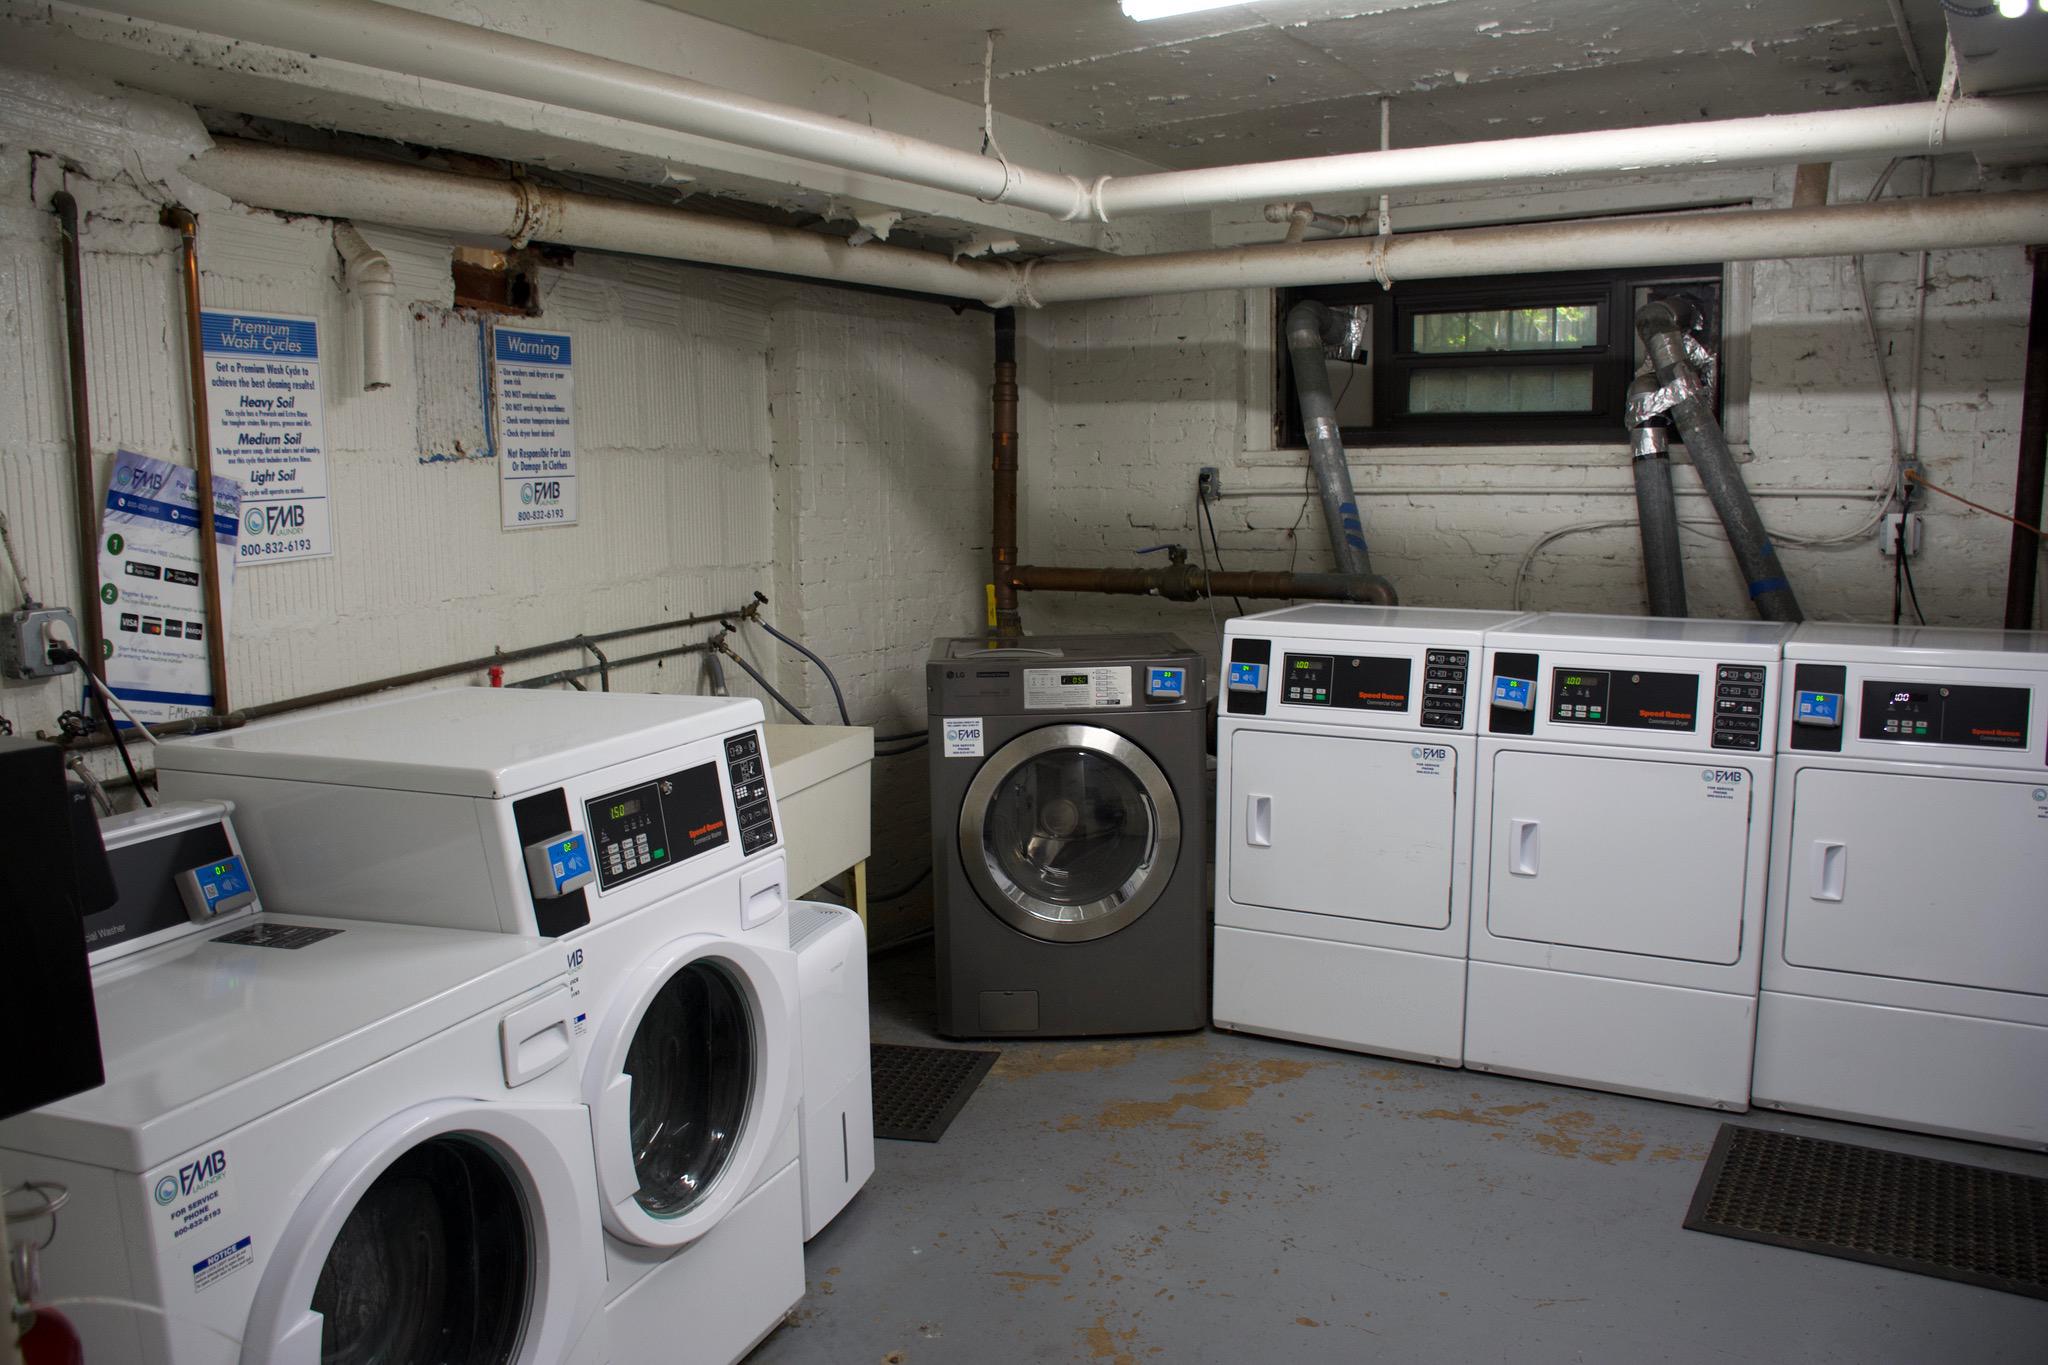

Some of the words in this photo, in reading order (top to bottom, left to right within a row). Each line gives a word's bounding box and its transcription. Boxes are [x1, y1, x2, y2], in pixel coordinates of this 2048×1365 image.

[232, 318, 290, 336] Premium
[221, 333, 258, 349] Wash
[263, 336, 302, 354] Cycles
[508, 336, 560, 361] Warning
[216, 361, 228, 372] Get
[230, 365, 235, 373] a
[236, 362, 266, 374] Premium
[266, 364, 284, 375] Wash
[286, 365, 300, 378] Cycle
[302, 367, 309, 376] to
[212, 376, 237, 388] achieve
[239, 377, 250, 388] the
[251, 378, 266, 389] best
[267, 378, 291, 392] cleaning
[292, 379, 315, 390] results!
[504, 390, 512, 398] DO
[512, 390, 522, 398] NOT
[240, 395, 274, 412] Heavy
[276, 396, 295, 409] Soil
[238, 432, 280, 446] Medium
[283, 432, 302, 446] Soil
[508, 448, 518, 458] Not
[519, 448, 549, 461] Responsible
[550, 448, 559, 458] For
[560, 448, 571, 458] Loss
[512, 461, 519, 472] Or
[520, 460, 541, 474] Damage
[542, 460, 548, 470] To
[548, 460, 568, 470] Clothes
[132, 468, 162, 490] FMB
[251, 469, 276, 486] Light
[278, 468, 296, 482] Soil
[534, 482, 560, 505] FMB
[266, 505, 304, 535] FMB
[518, 508, 564, 521] 800-832-6193
[276, 527, 304, 537] LAUNDRY
[241, 540, 311, 556] 800-832-6193
[106, 588, 112, 599] 2
[122, 617, 138, 627] VISA
[1359, 691, 1380, 700] Speed
[1382, 692, 1404, 701] Queen
[1639, 709, 1664, 718] Speed
[1665, 710, 1692, 720] Queen
[958, 729, 980, 741] FMB
[1423, 748, 1446, 760] FMB
[1715, 770, 1742, 784] FMB
[689, 826, 706, 838] Speed
[706, 820, 724, 831] Queen
[564, 842, 572, 852] 02
[215, 866, 226, 875] 01
[98, 923, 126, 938] Washer
[179, 1150, 226, 1196] FMB
[192, 1172, 227, 1194] LAUNDRY
[171, 1207, 187, 1220] FOR
[187, 1190, 219, 1211] SERVICE
[184, 1205, 210, 1223] PHONE
[174, 1208, 222, 1238] 800-832-6193
[208, 1244, 238, 1266] NOTICE
